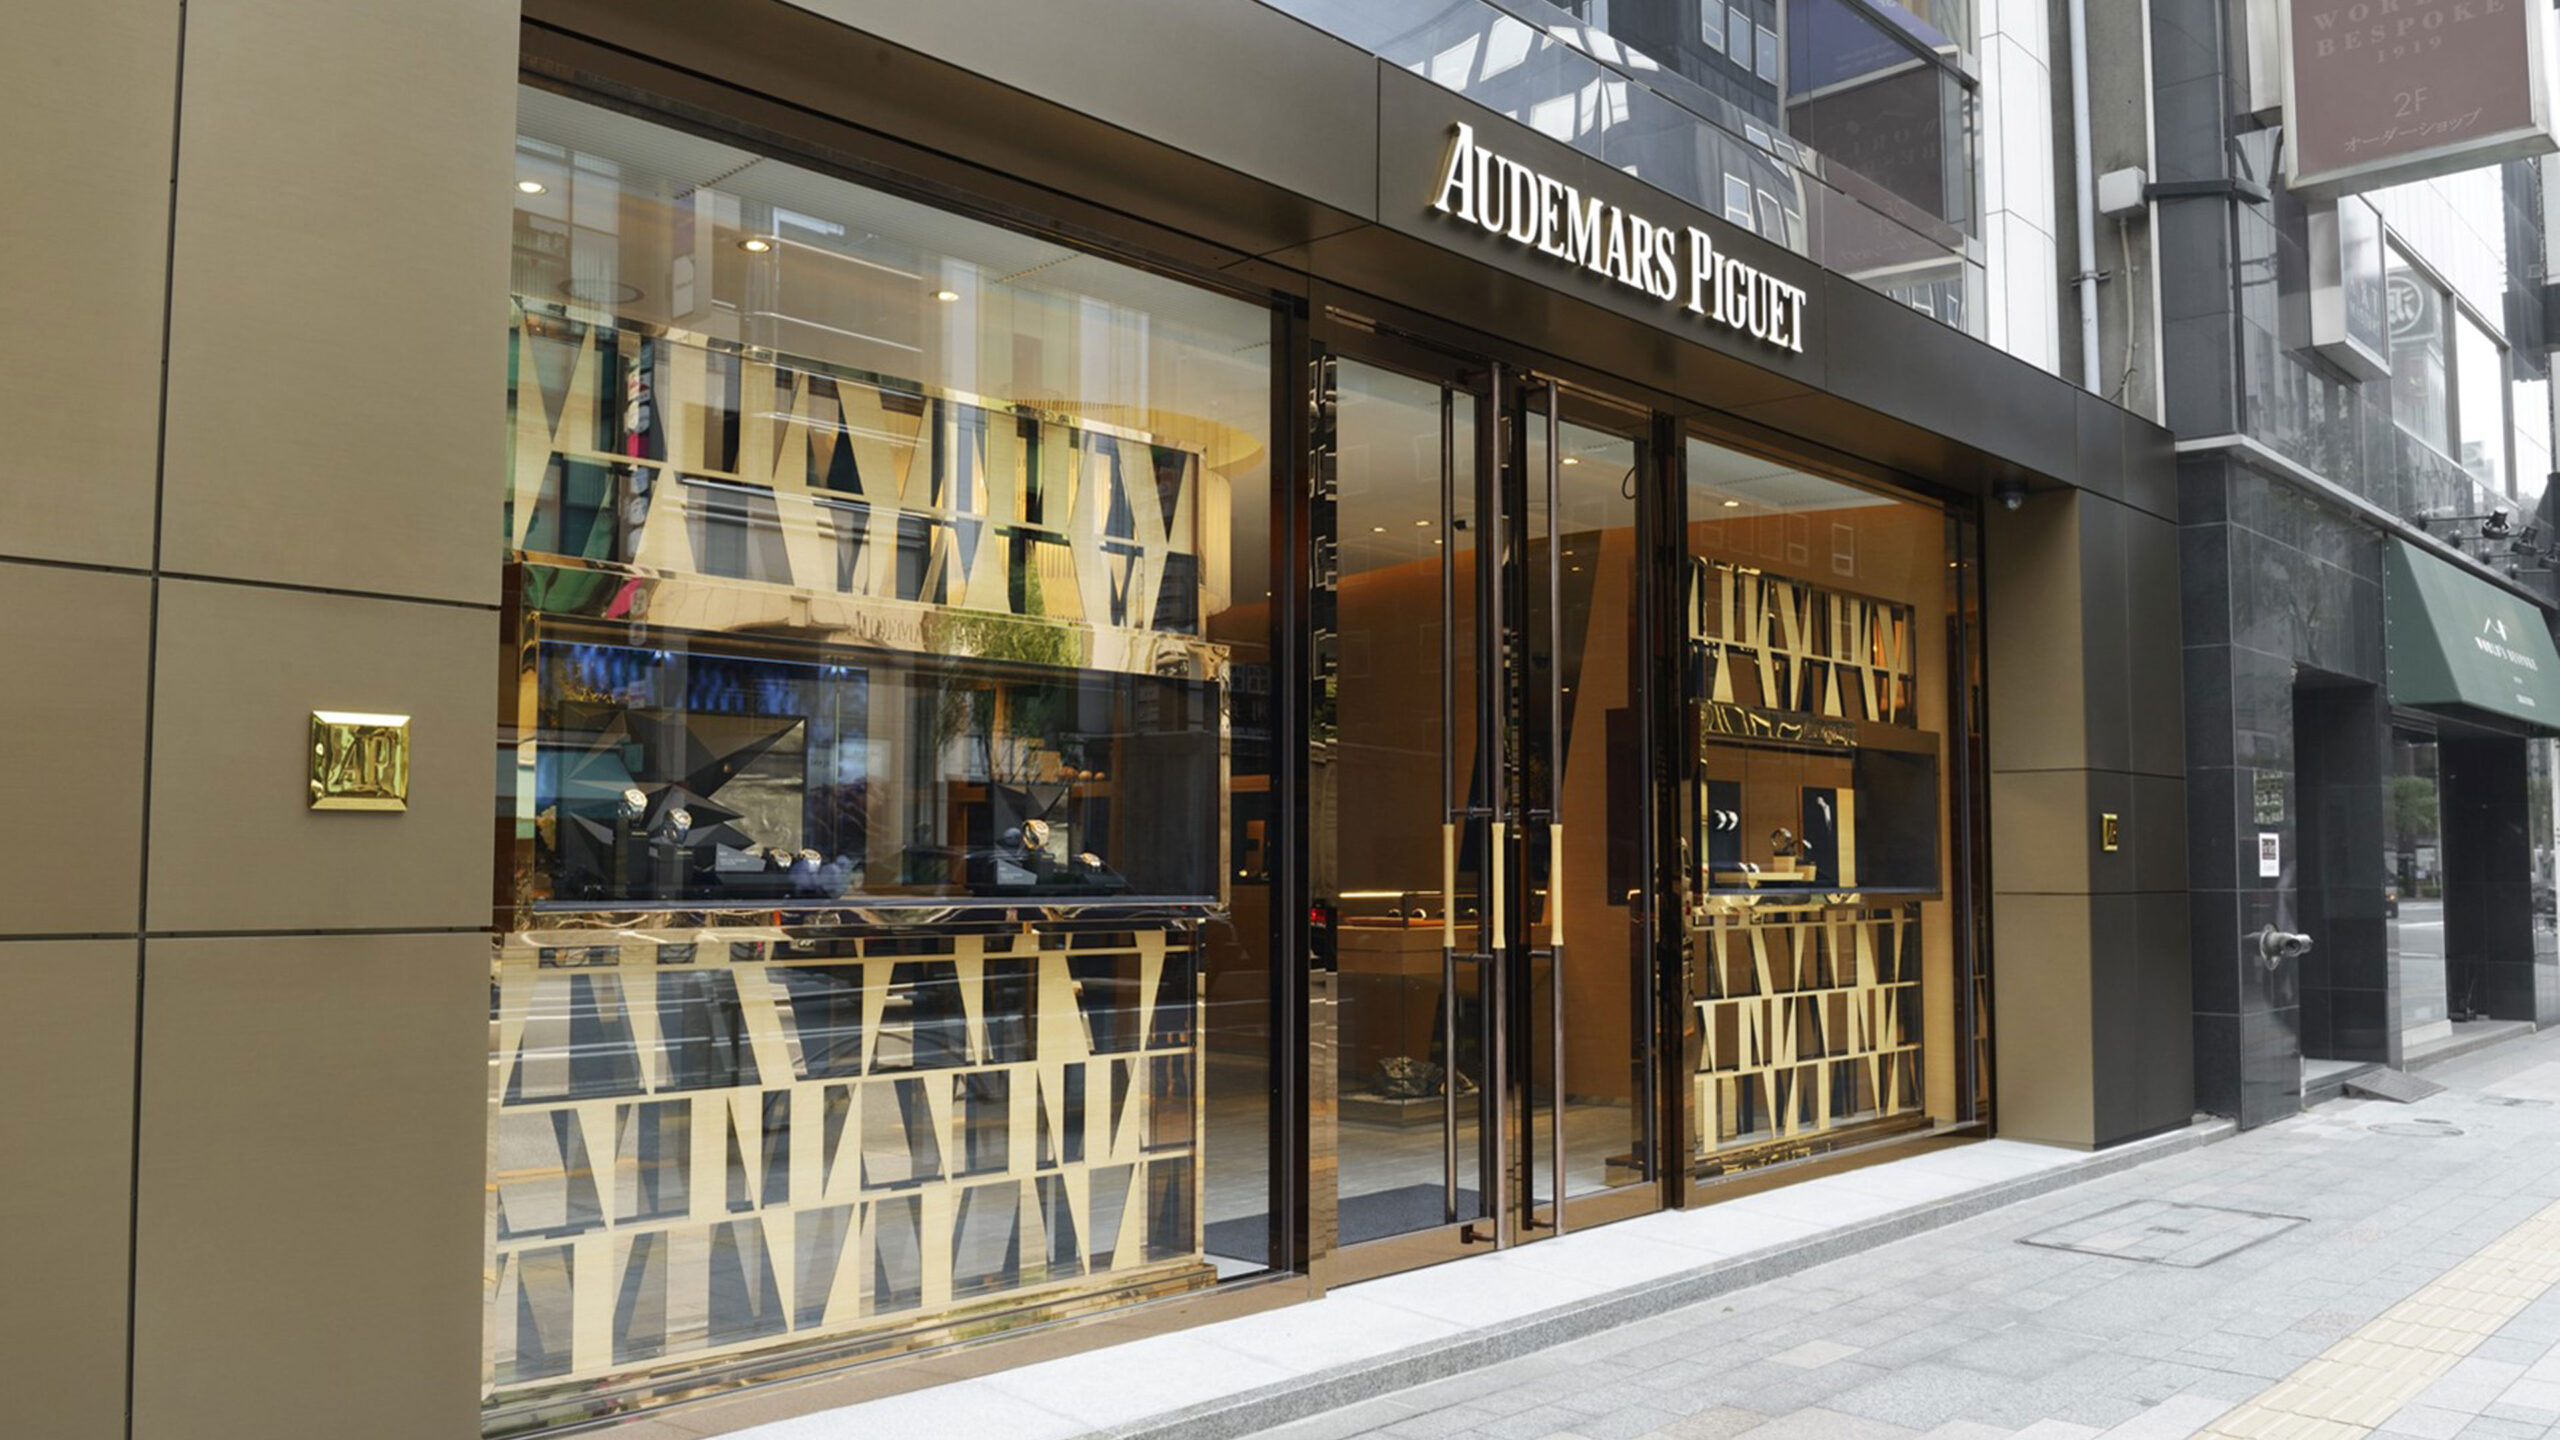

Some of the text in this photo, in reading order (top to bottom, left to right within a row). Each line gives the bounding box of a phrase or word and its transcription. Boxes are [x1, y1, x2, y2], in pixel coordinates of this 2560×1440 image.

[2315, 0, 2506, 57] BESPOKE
[2376, 35, 2442, 64] 1919
[2393, 87, 2428, 118] 2F
[1432, 121, 1807, 353] AUDEMARS PIGUET
